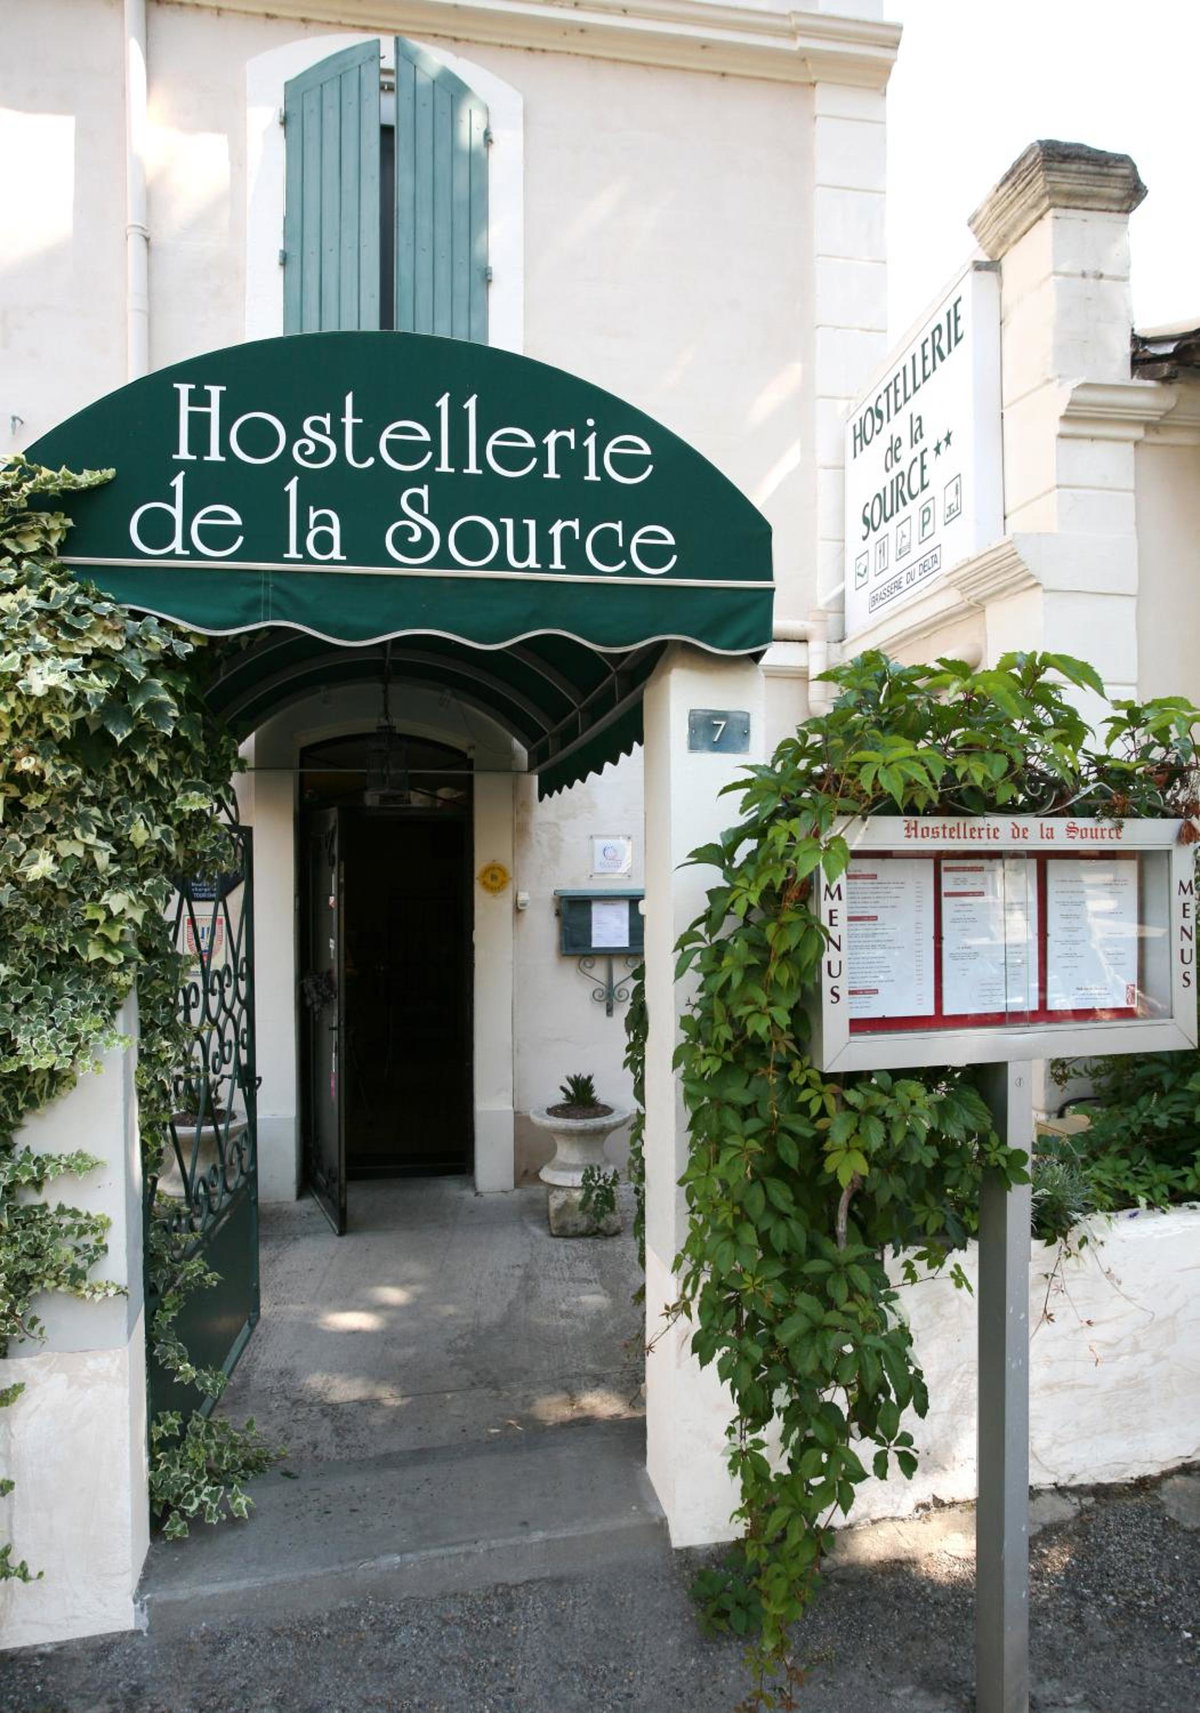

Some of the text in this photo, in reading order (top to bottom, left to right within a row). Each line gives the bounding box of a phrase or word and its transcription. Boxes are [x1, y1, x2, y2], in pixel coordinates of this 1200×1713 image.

[852, 295, 965, 461] HOSTELLERIE
[172, 383, 654, 485] Hostellerie
[884, 412, 924, 474] de la
[128, 470, 678, 576] de la Source
[861, 447, 930, 542] SOURCE
[870, 554, 939, 608] BRASSERIE DU DELTA
[713, 720, 727, 742] 7
[902, 819, 1124, 841] Hostellerie de la Source
[823, 882, 843, 1006] MENUS
[1177, 878, 1194, 989] MENUS
